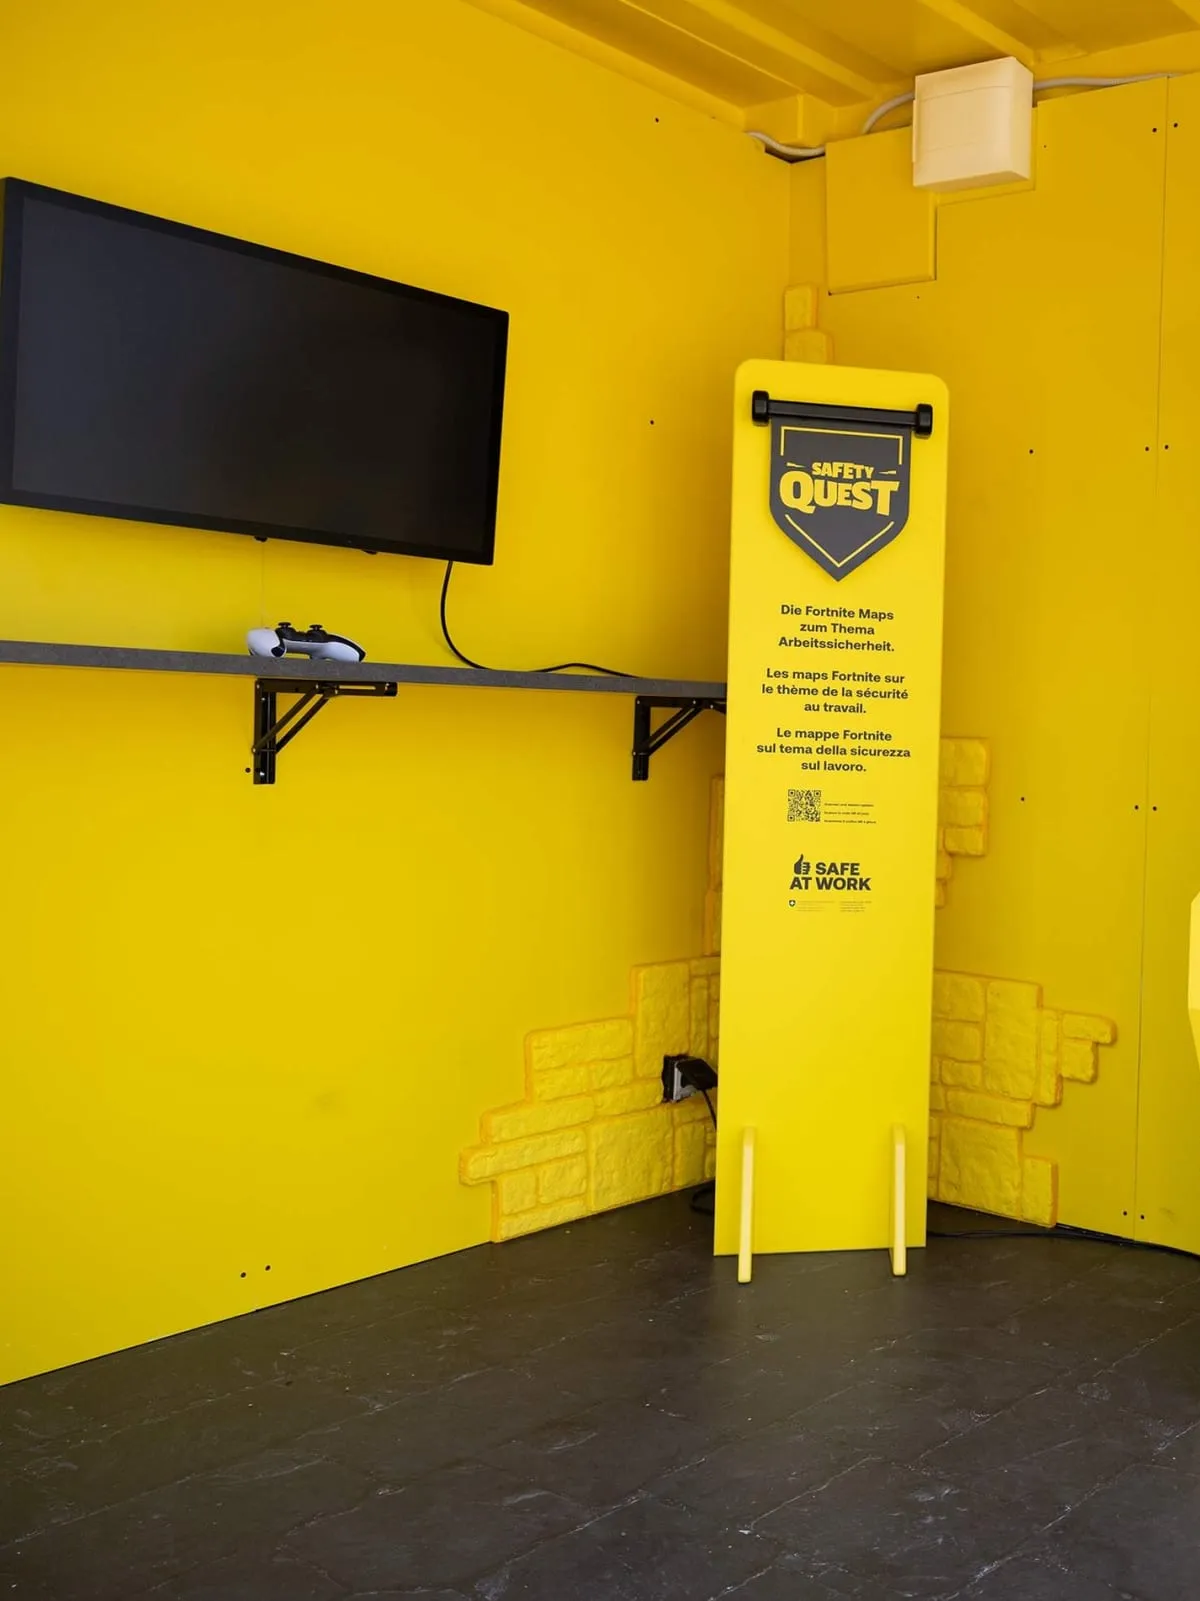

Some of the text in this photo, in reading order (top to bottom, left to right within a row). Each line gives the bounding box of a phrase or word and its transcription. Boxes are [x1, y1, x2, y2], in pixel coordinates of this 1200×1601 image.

[812, 462, 874, 478] SAFETY
[780, 471, 899, 516] QUEST
[781, 604, 894, 621] Die Fortnite Maps
[800, 624, 874, 635] zum Thema
[779, 637, 894, 652] Arbeitssicherheit.
[766, 668, 905, 683] Les maps Fortnite sur
[762, 684, 908, 699] le thème de la sécurité
[804, 703, 866, 713] au travail.
[777, 728, 892, 742] Le mappe Fortnite
[757, 743, 910, 757] sul tema della sicurezza
[801, 761, 866, 772] sul lavoro.
[816, 862, 860, 875] SAFE
[790, 877, 871, 890] AT WORK
